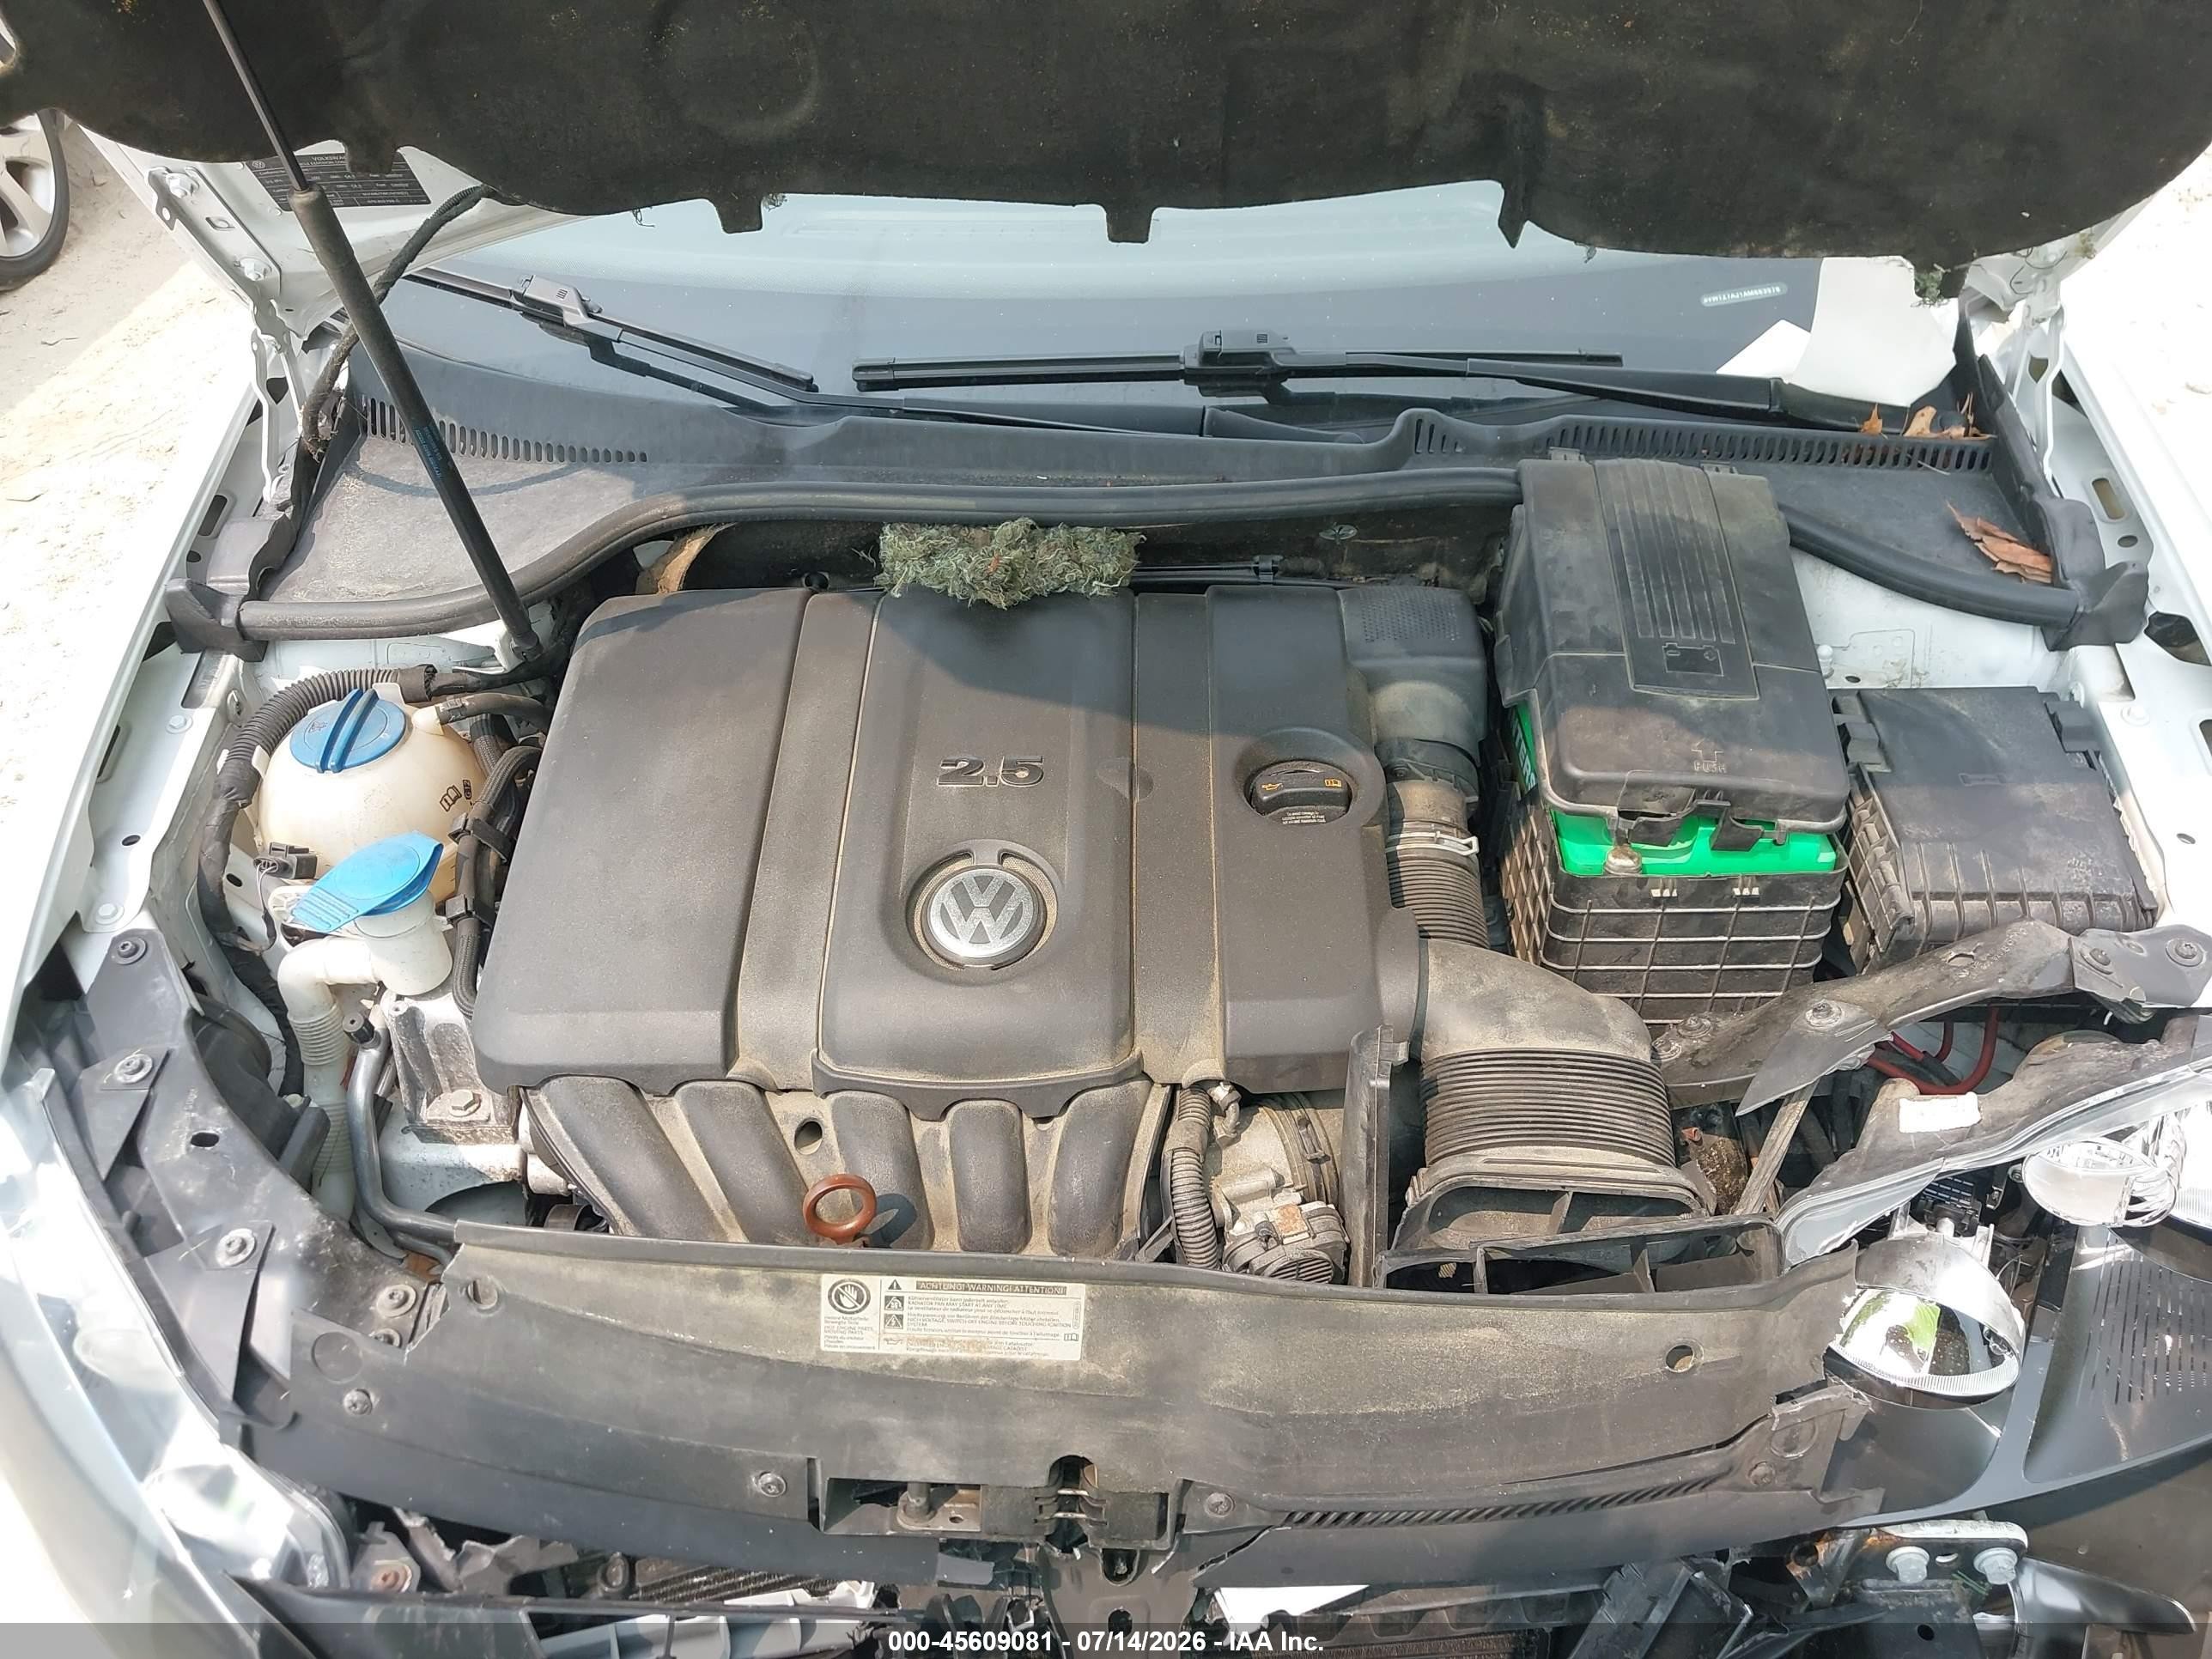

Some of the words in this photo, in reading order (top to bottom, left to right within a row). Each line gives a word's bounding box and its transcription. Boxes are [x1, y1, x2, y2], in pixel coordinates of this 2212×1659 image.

[937, 755, 1045, 787] 2.5
[1693, 760, 1728, 774] PUSH
[920, 1282, 965, 1291] ACHTUNG!
[967, 1283, 1012, 1292] WARNING!
